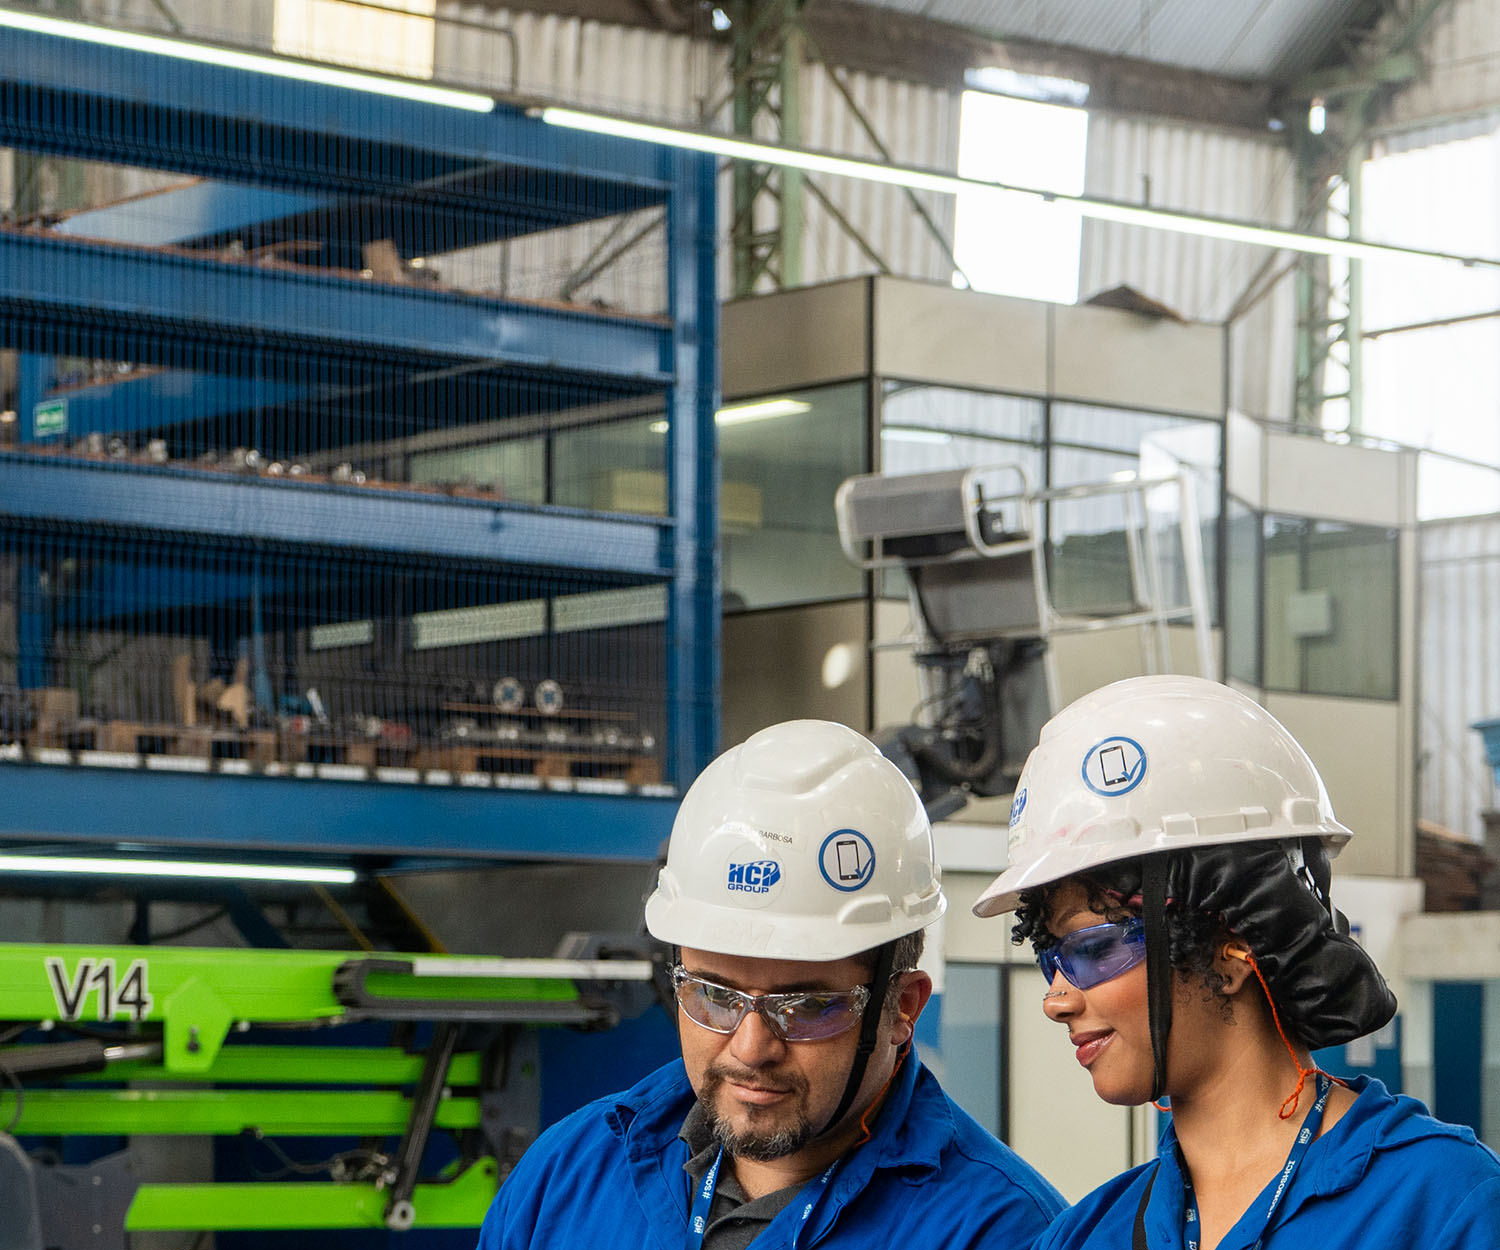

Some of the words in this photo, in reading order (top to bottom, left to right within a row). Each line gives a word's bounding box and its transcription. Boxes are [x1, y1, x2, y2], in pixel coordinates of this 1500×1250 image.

[728, 860, 781, 887] HCI
[727, 883, 769, 894] GROUP
[45, 957, 154, 1021] V14
